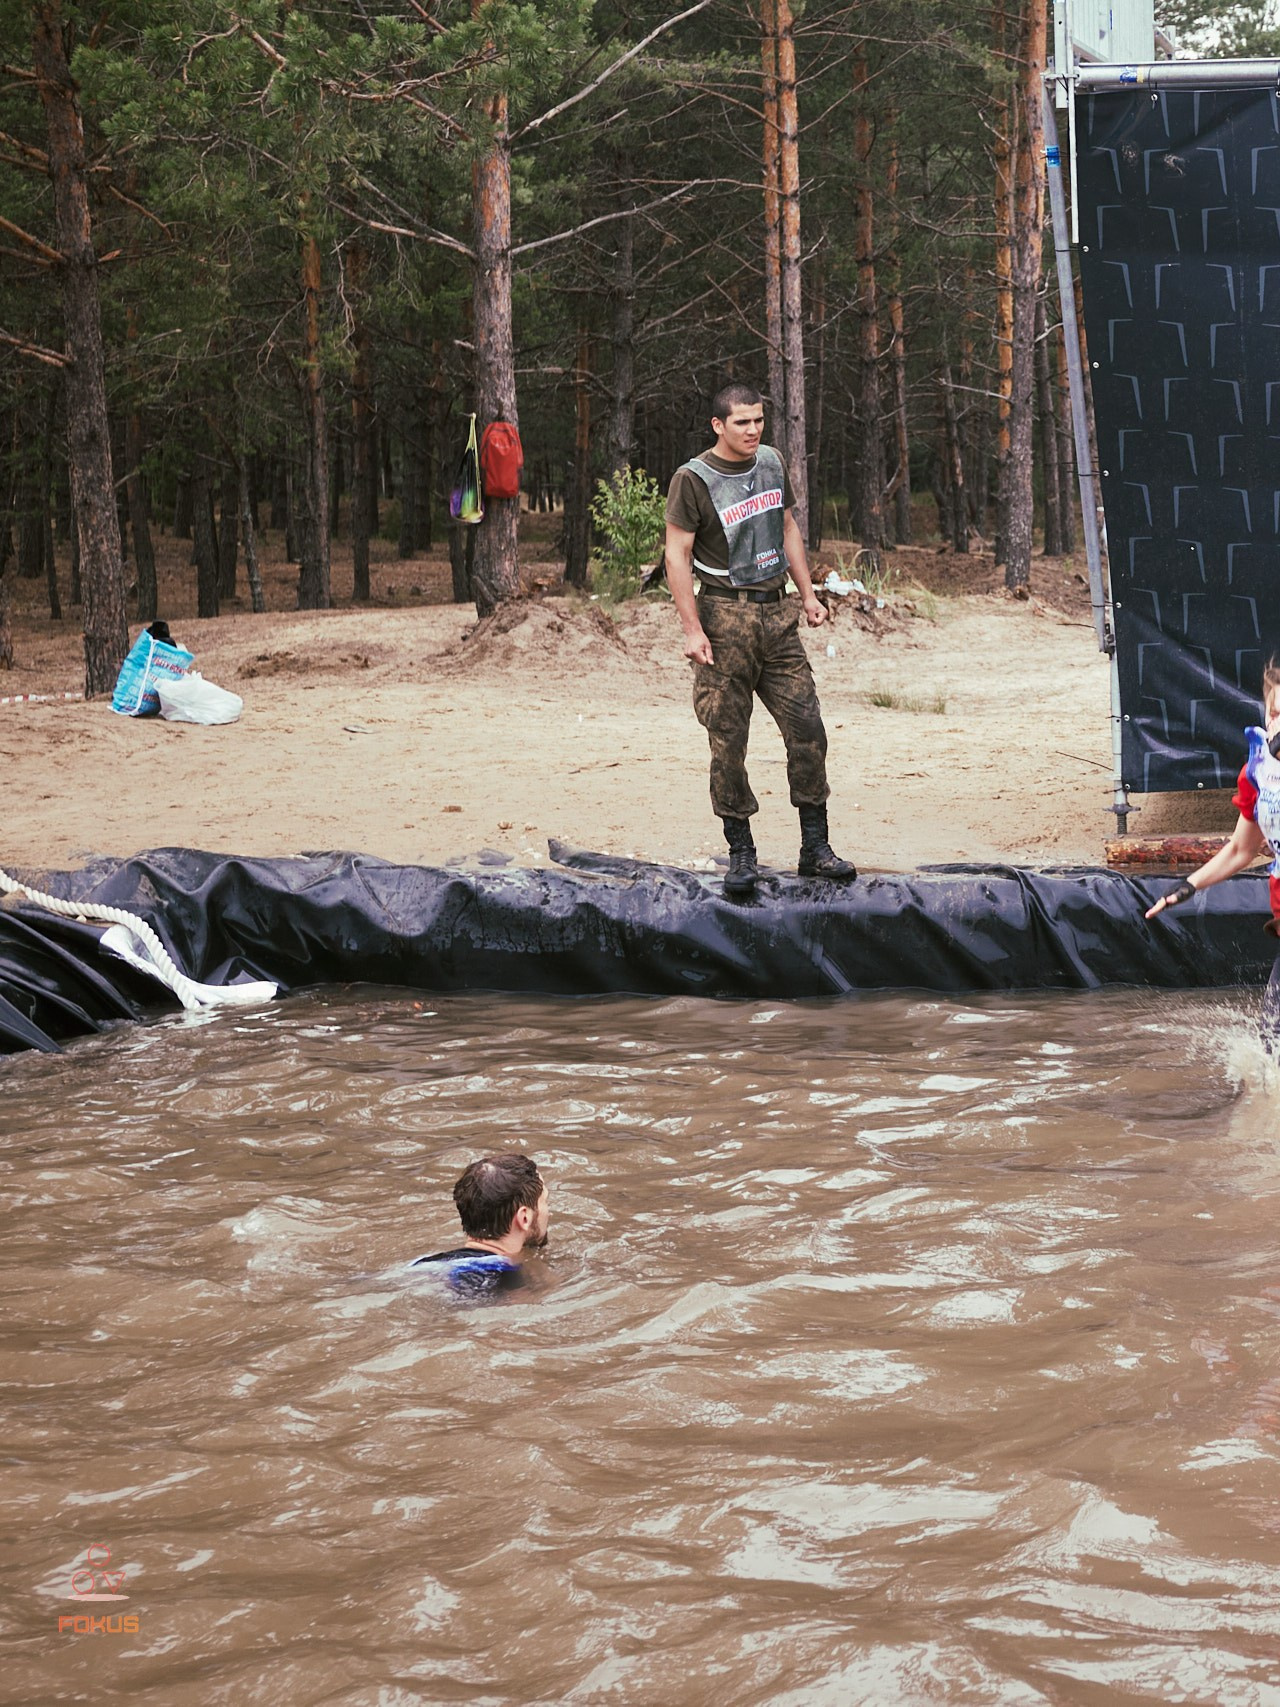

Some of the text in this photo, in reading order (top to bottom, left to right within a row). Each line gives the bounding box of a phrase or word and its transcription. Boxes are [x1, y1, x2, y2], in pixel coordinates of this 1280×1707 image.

[724, 491, 782, 525] ИНСТРУКТОР
[755, 548, 777, 561] ГОНКА
[757, 556, 780, 570] ГЕРОЕВ
